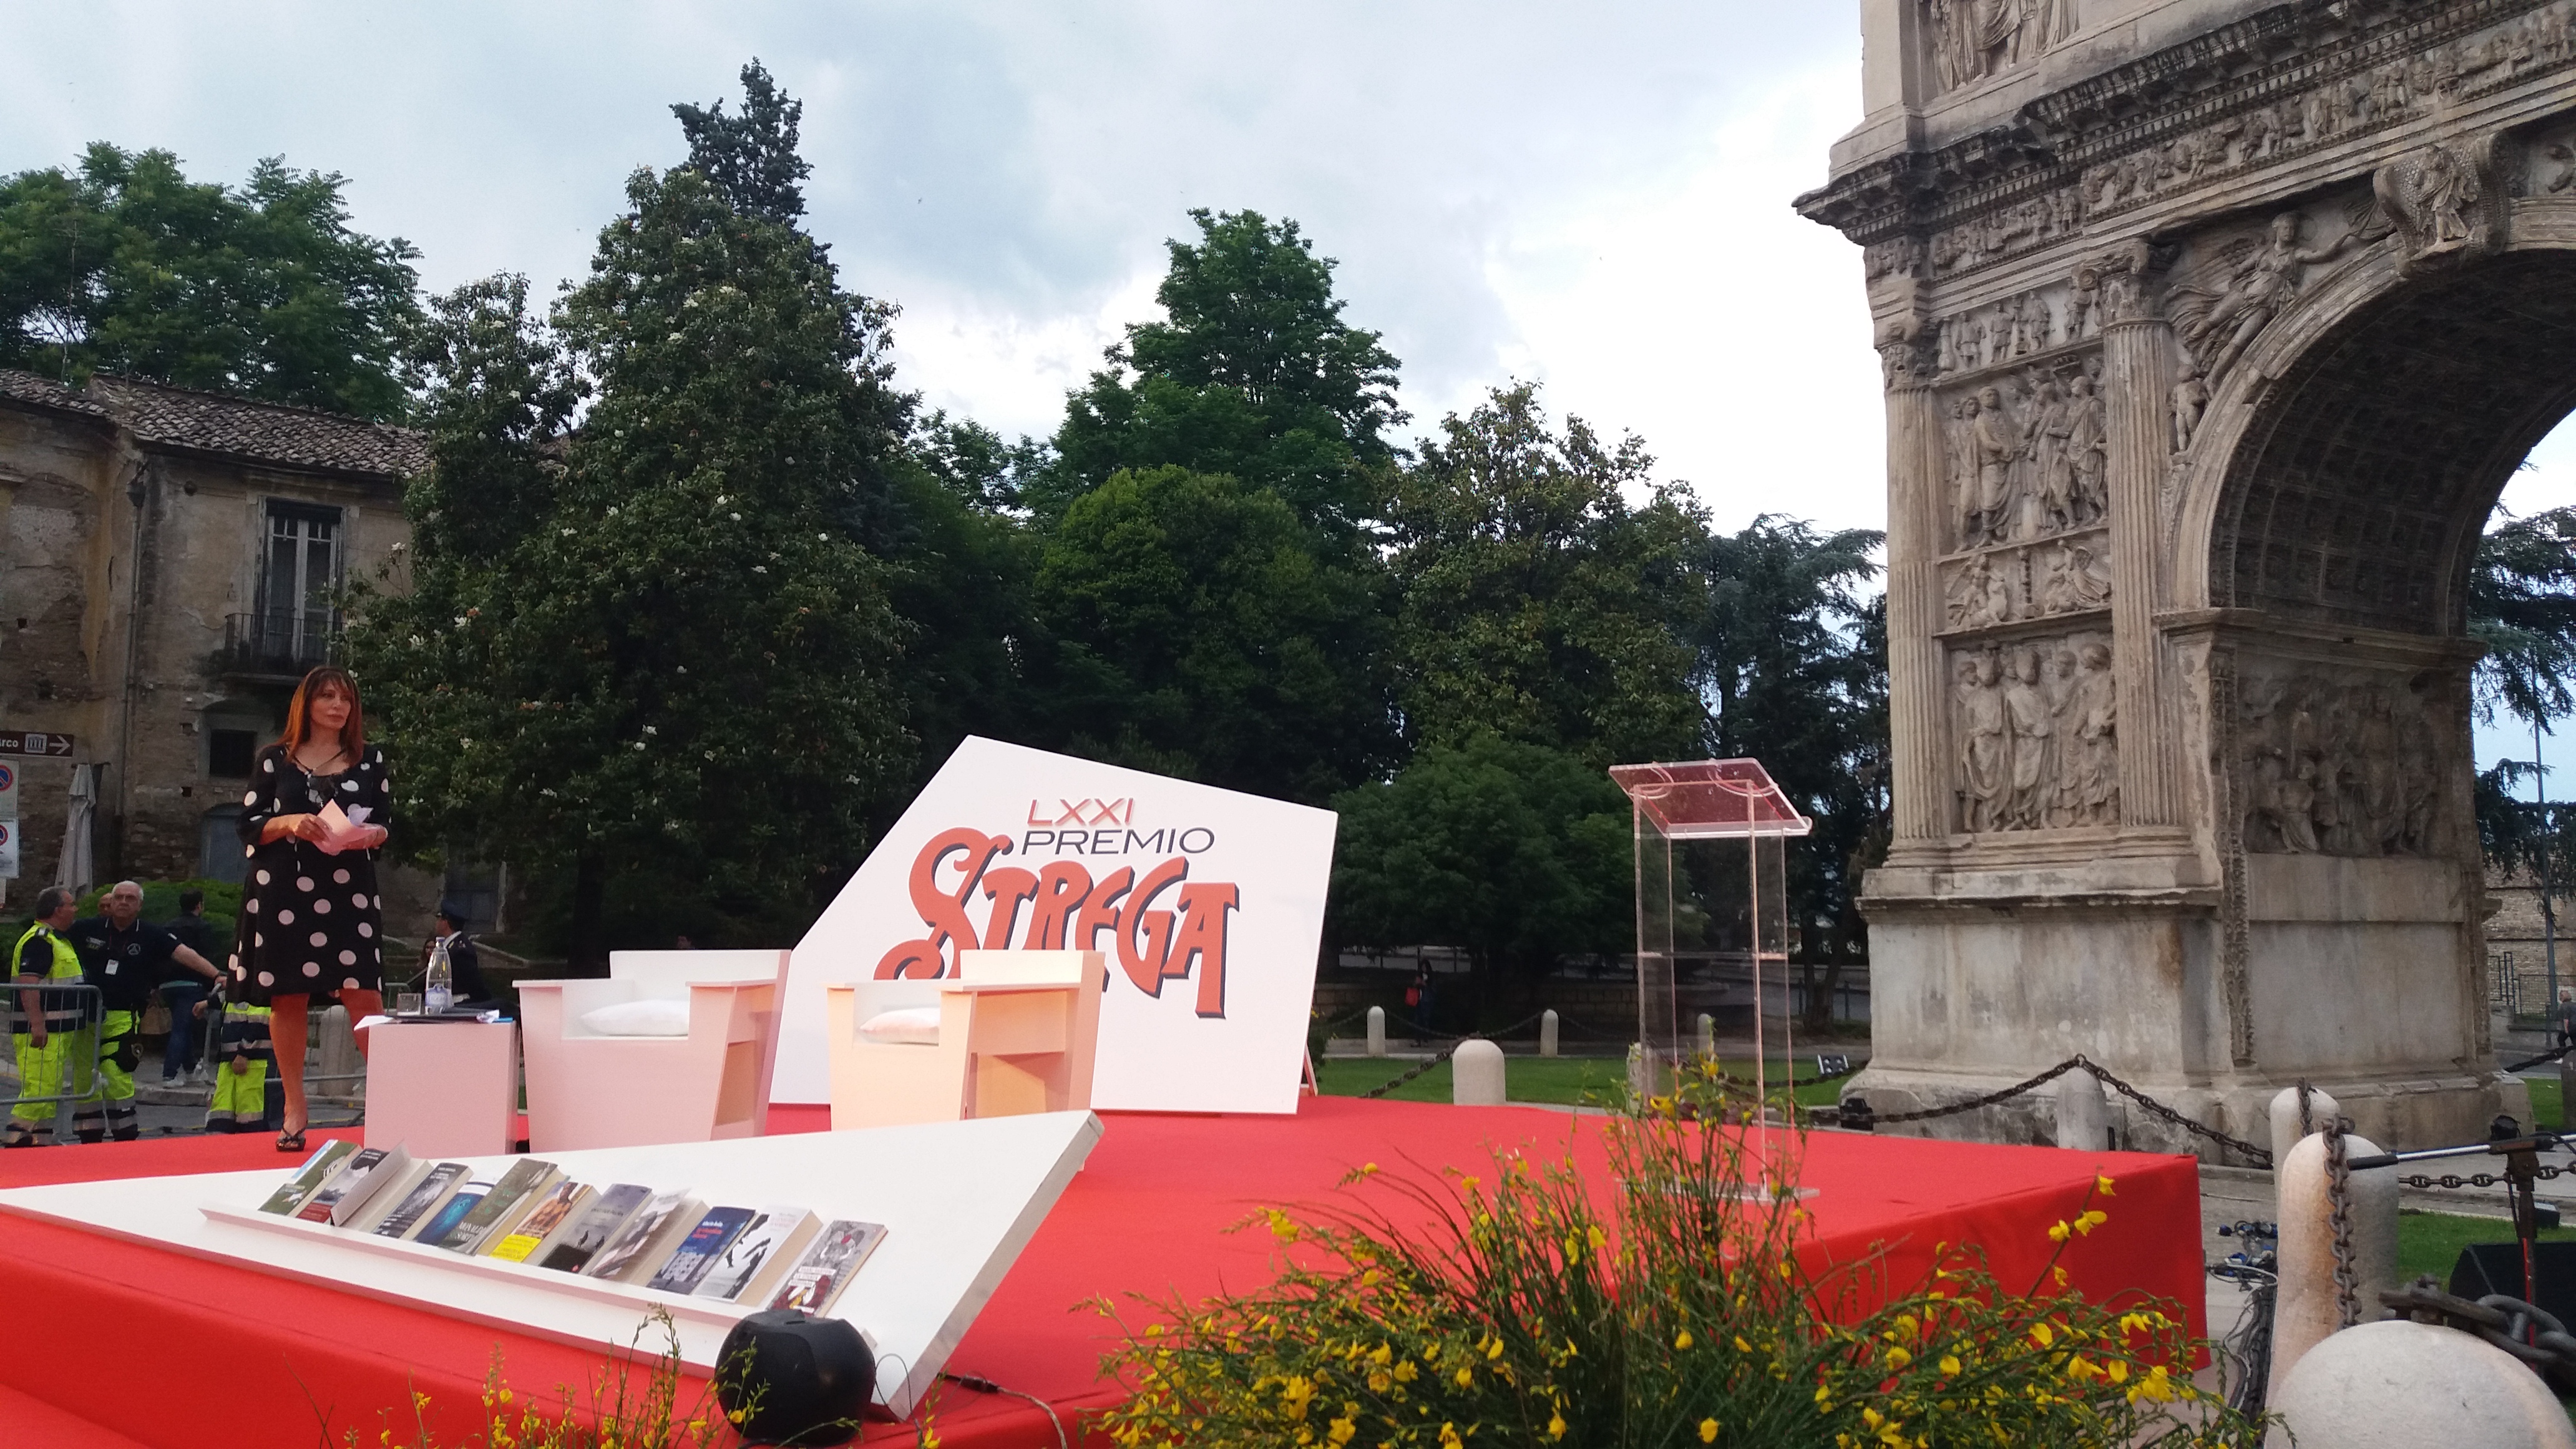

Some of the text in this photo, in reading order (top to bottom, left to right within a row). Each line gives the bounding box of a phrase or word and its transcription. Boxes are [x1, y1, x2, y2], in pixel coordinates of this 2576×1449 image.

[0, 739, 19, 748] rco
[1027, 798, 1134, 827] LXXI
[1021, 826, 1215, 856] PREMIO
